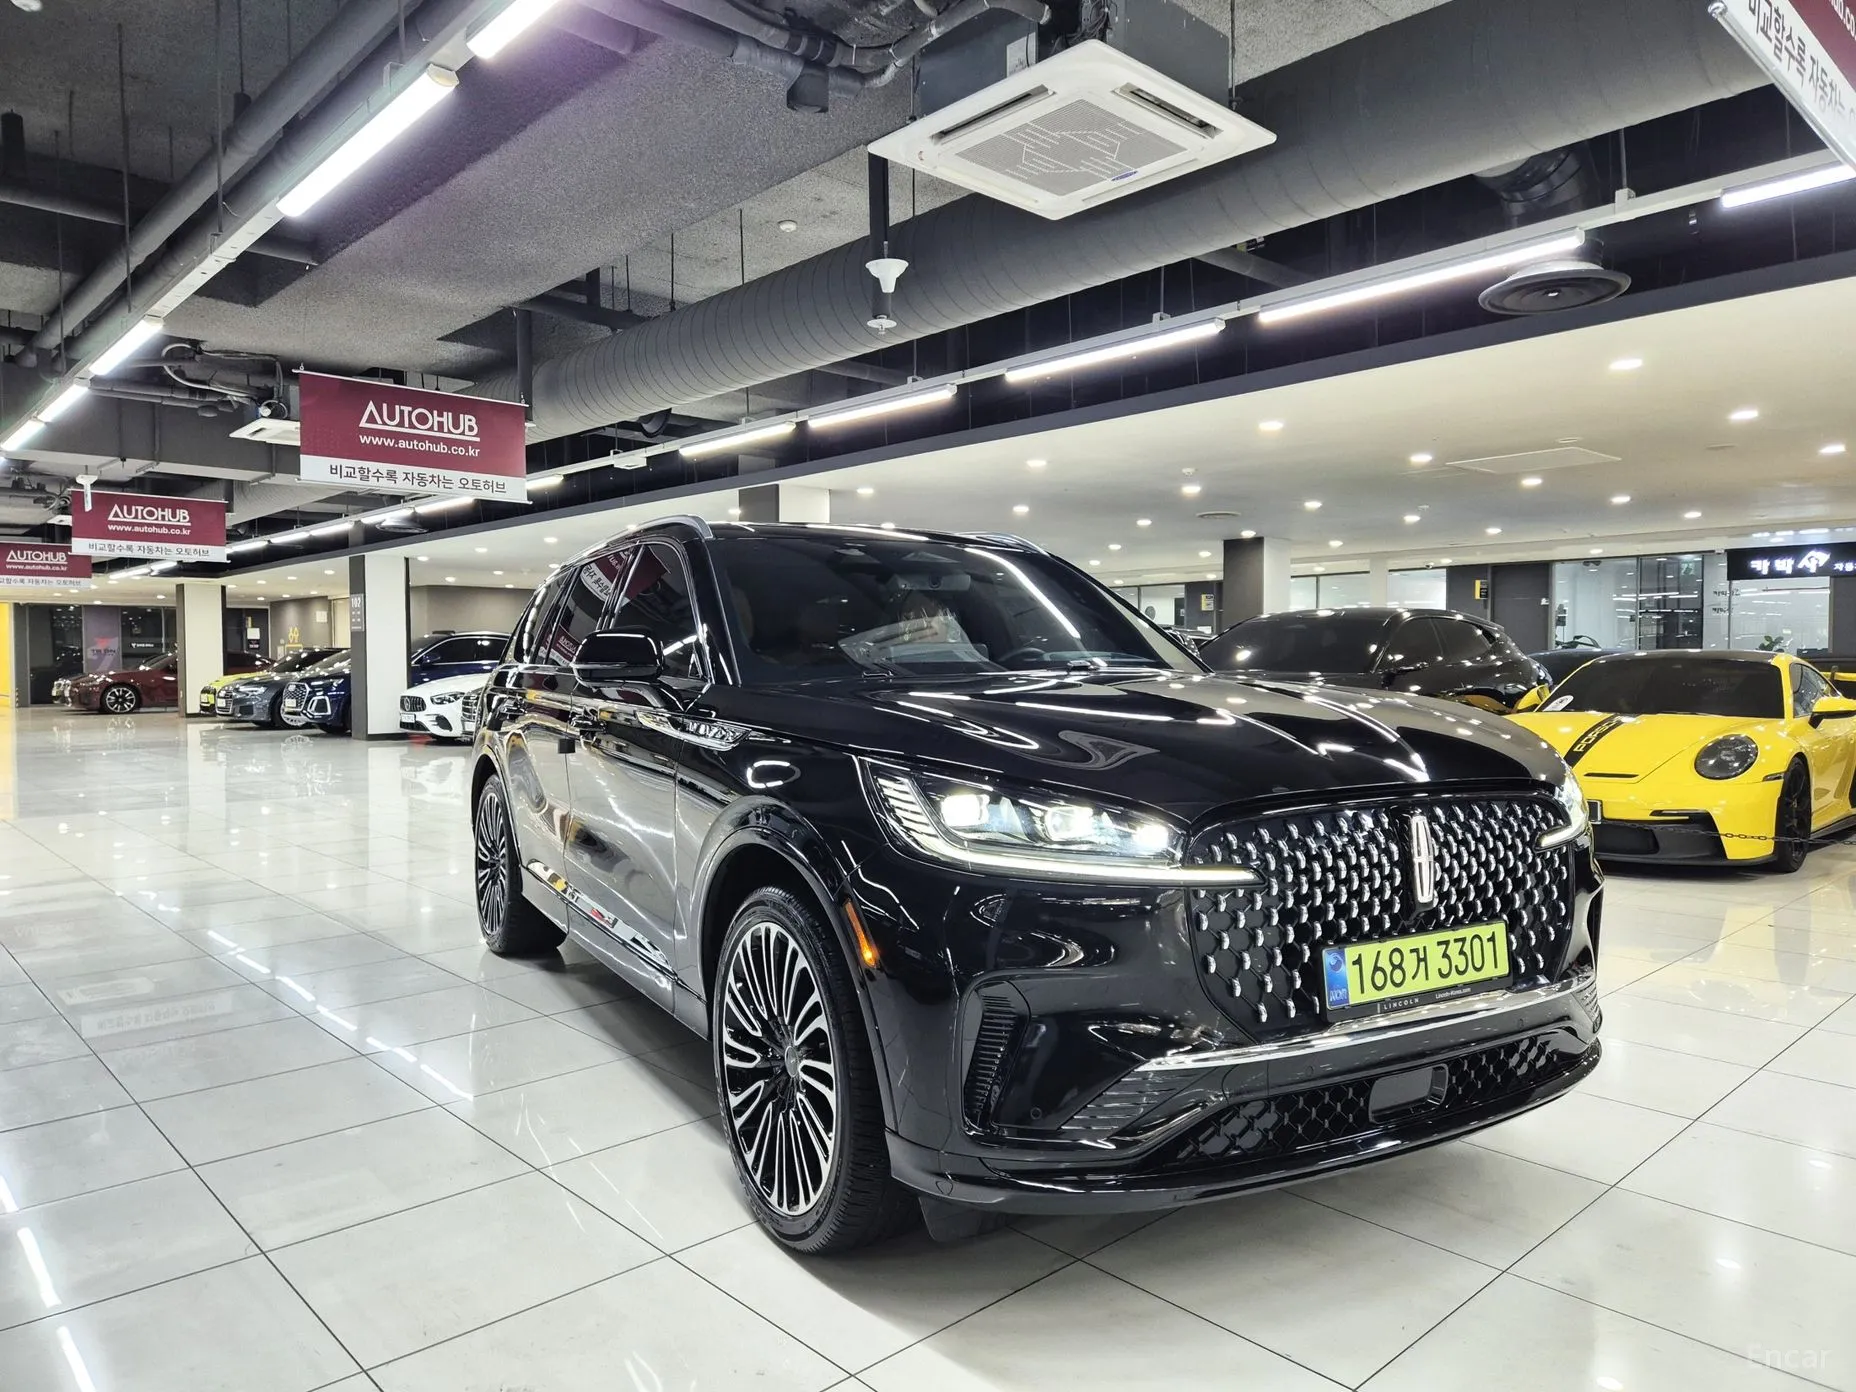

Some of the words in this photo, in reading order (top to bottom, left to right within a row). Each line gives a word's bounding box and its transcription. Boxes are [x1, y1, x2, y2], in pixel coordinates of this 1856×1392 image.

[359, 400, 480, 441] AUTOHUB
[359, 434, 480, 457] www.autohub.co.kr
[330, 464, 398, 484] 비교할수록
[402, 472, 454, 490] 자동차는
[458, 477, 506, 494] 오토허브
[108, 504, 191, 526] AUTOHUB
[108, 523, 191, 536] www.autohub.co.kr
[6, 550, 67, 563] AUTOHUB
[88, 543, 134, 554] 비교할수록
[137, 545, 173, 555] 자동차는
[175, 547, 210, 557] 오토허브
[6, 563, 67, 571] www.autohub.co.kr
[1833, 562, 1856, 572] 자동
[1573, 715, 1624, 752] PORSC
[1352, 946, 1430, 994] 168거
[1437, 931, 1498, 979] 3301
[1383, 998, 1419, 1010] LINCOLN
